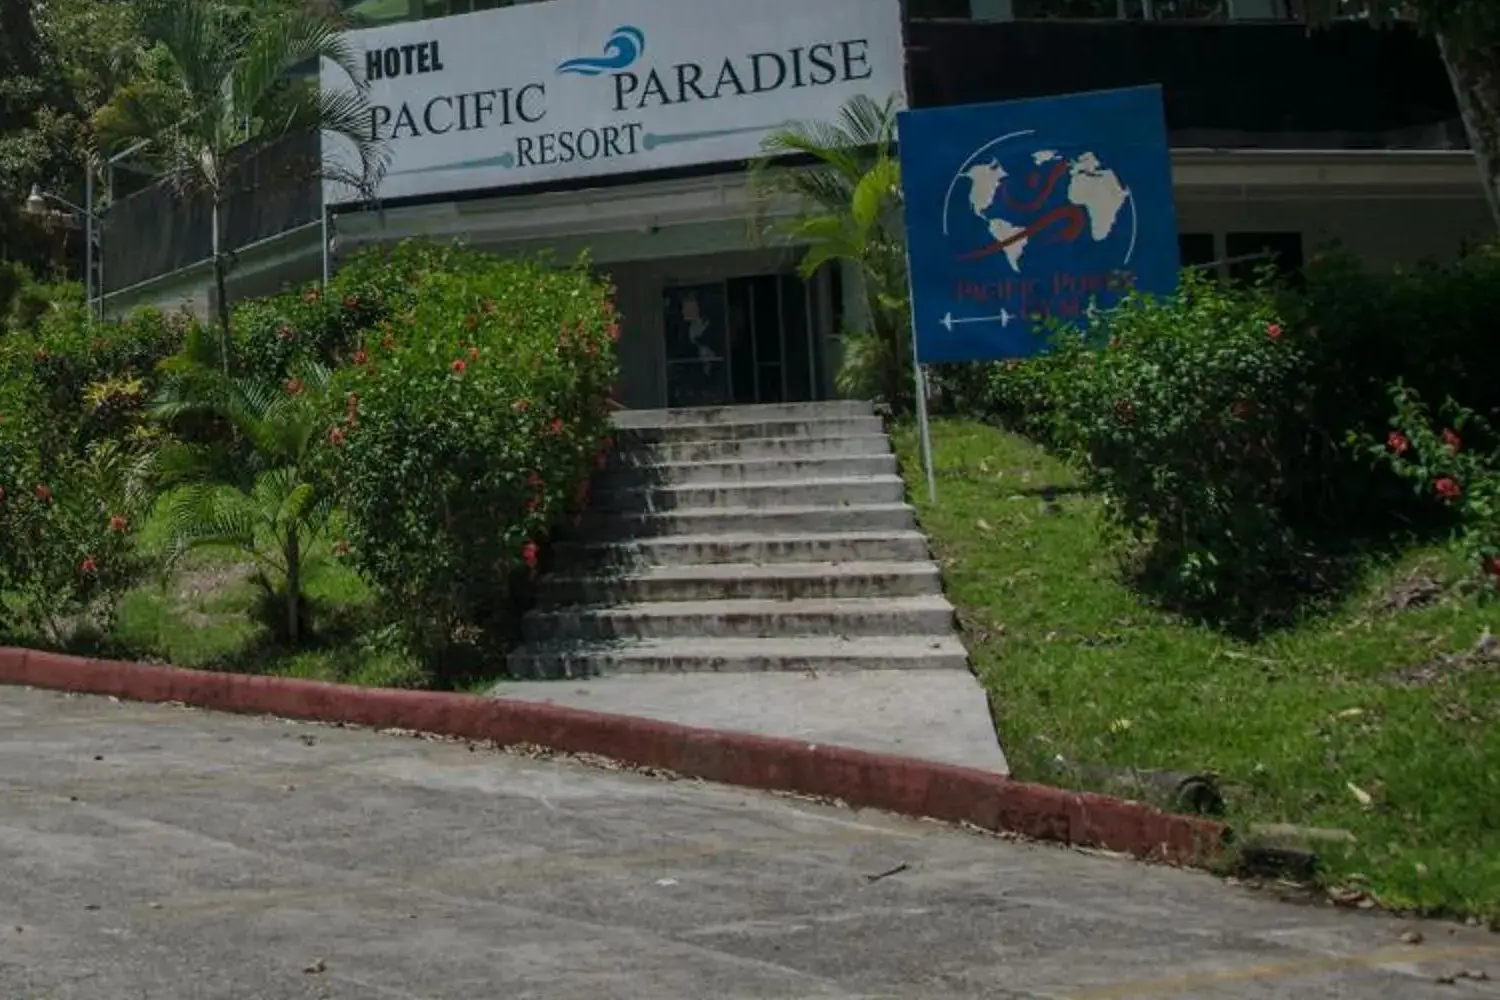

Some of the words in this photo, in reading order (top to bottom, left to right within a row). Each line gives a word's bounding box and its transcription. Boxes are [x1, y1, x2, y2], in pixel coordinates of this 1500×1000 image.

[366, 40, 443, 81] HOTEL
[369, 83, 547, 142] PACIFIC
[612, 39, 873, 112] PARADISE
[515, 123, 643, 169] RESORT
